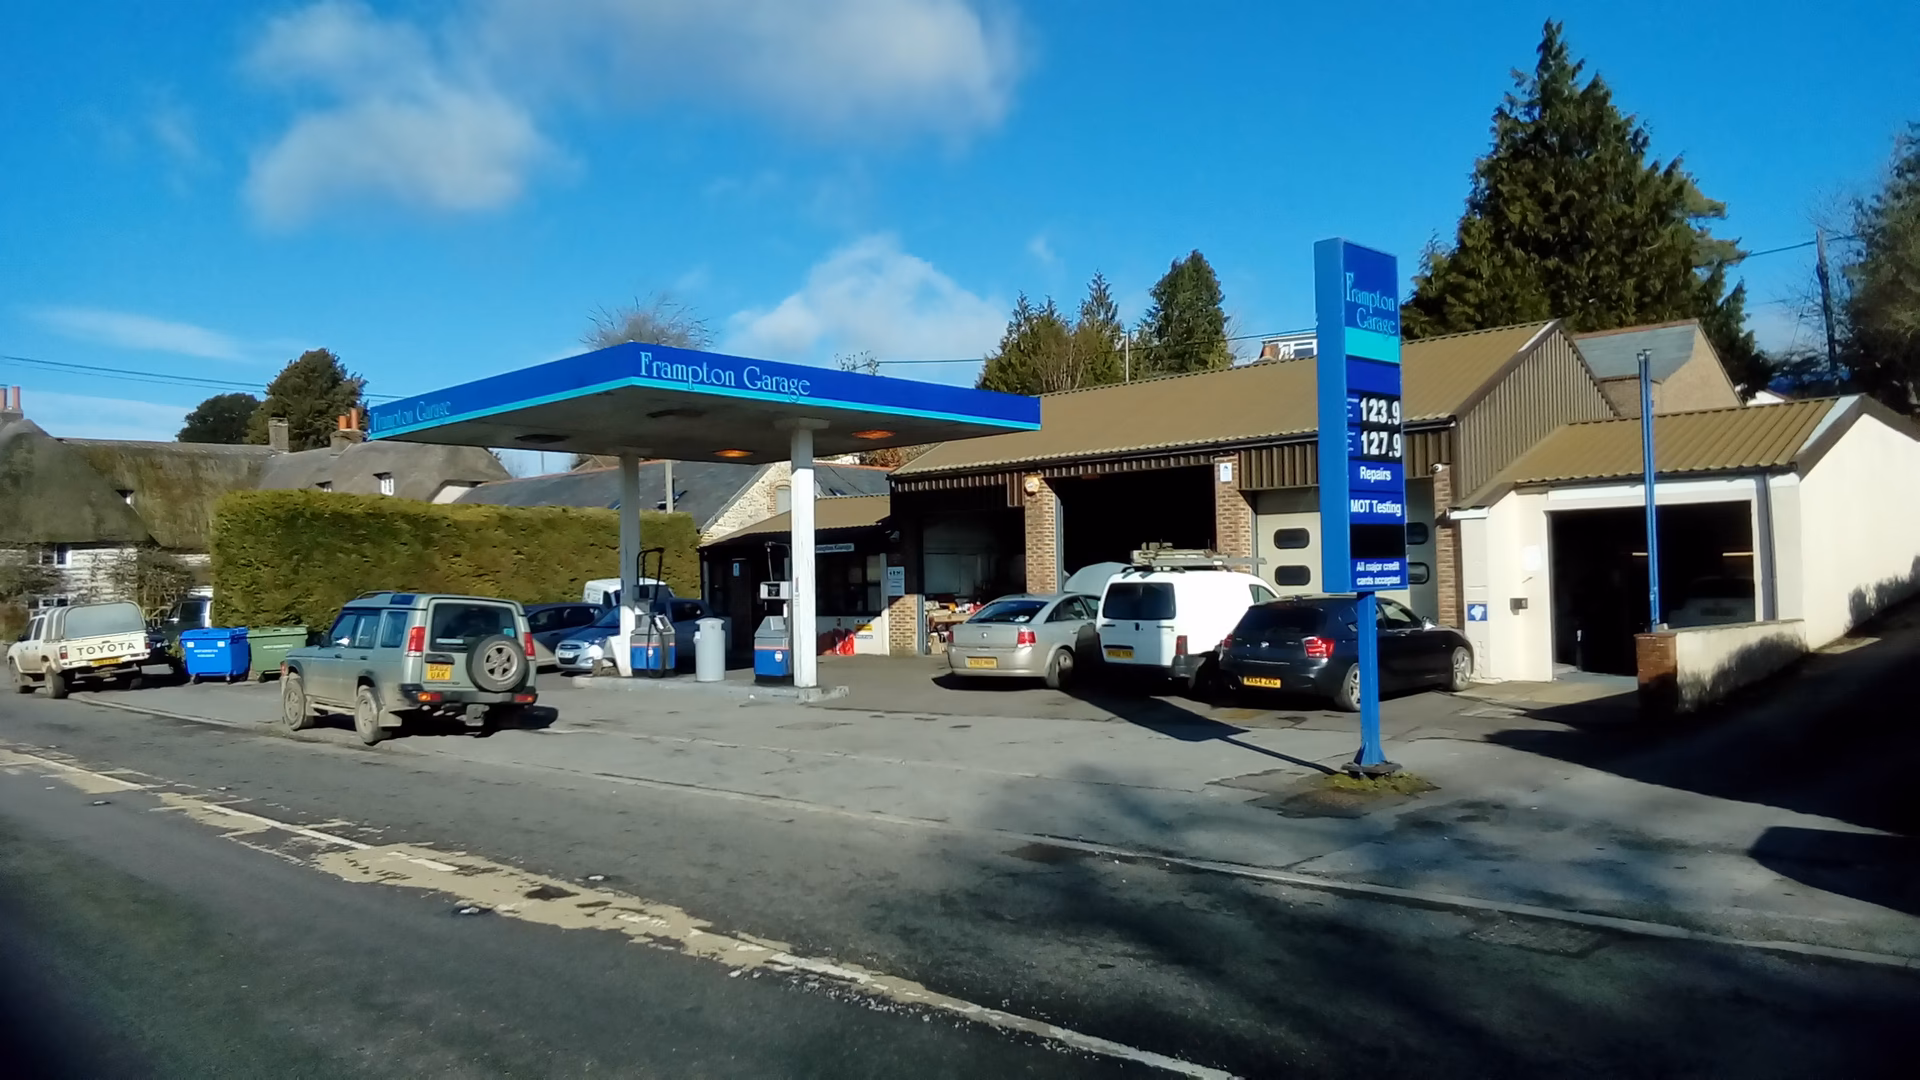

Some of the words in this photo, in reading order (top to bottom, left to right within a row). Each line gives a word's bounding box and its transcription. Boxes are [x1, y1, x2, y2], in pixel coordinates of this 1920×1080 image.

[1345, 271, 1395, 314] Frampton
[1356, 307, 1397, 338] Garage
[639, 351, 736, 391] Frampton
[743, 365, 811, 404] Garage
[1360, 397, 1400, 425] 123.9
[1361, 430, 1401, 458] 127.9
[1359, 466, 1392, 483] Repairs
[1350, 499, 1371, 513] MOT
[1371, 499, 1402, 517] Testing
[1356, 561, 1365, 572] All
[1365, 561, 1383, 573] major
[1383, 561, 1400, 571] credit
[1356, 576, 1373, 585] cards
[1374, 575, 1401, 586] accepted
[76, 642, 136, 656] TOYOTA
